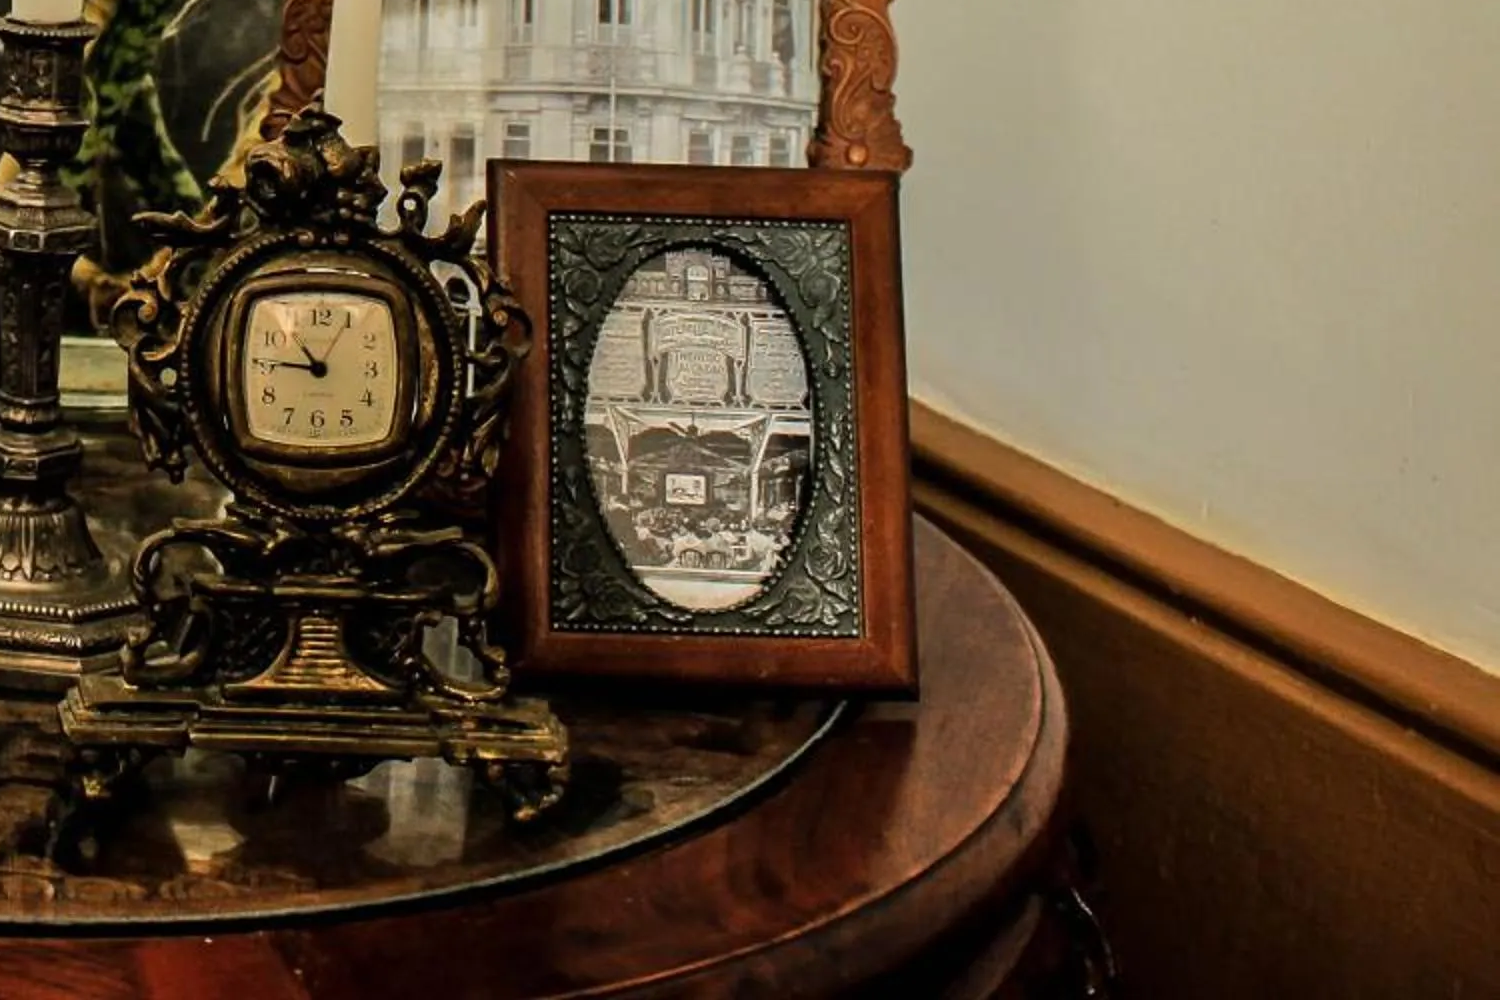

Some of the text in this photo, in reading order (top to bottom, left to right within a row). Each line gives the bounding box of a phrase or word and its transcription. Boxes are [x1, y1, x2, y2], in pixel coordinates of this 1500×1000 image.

[311, 308, 332, 326] 12
[345, 311, 351, 328] 1
[264, 330, 287, 347] 10
[363, 333, 376, 350] 2
[364, 360, 378, 378] 3
[261, 386, 276, 404] 8
[359, 388, 375, 407] 4
[283, 407, 295, 425] 7
[310, 409, 325, 428] 6
[340, 409, 353, 428] 5
